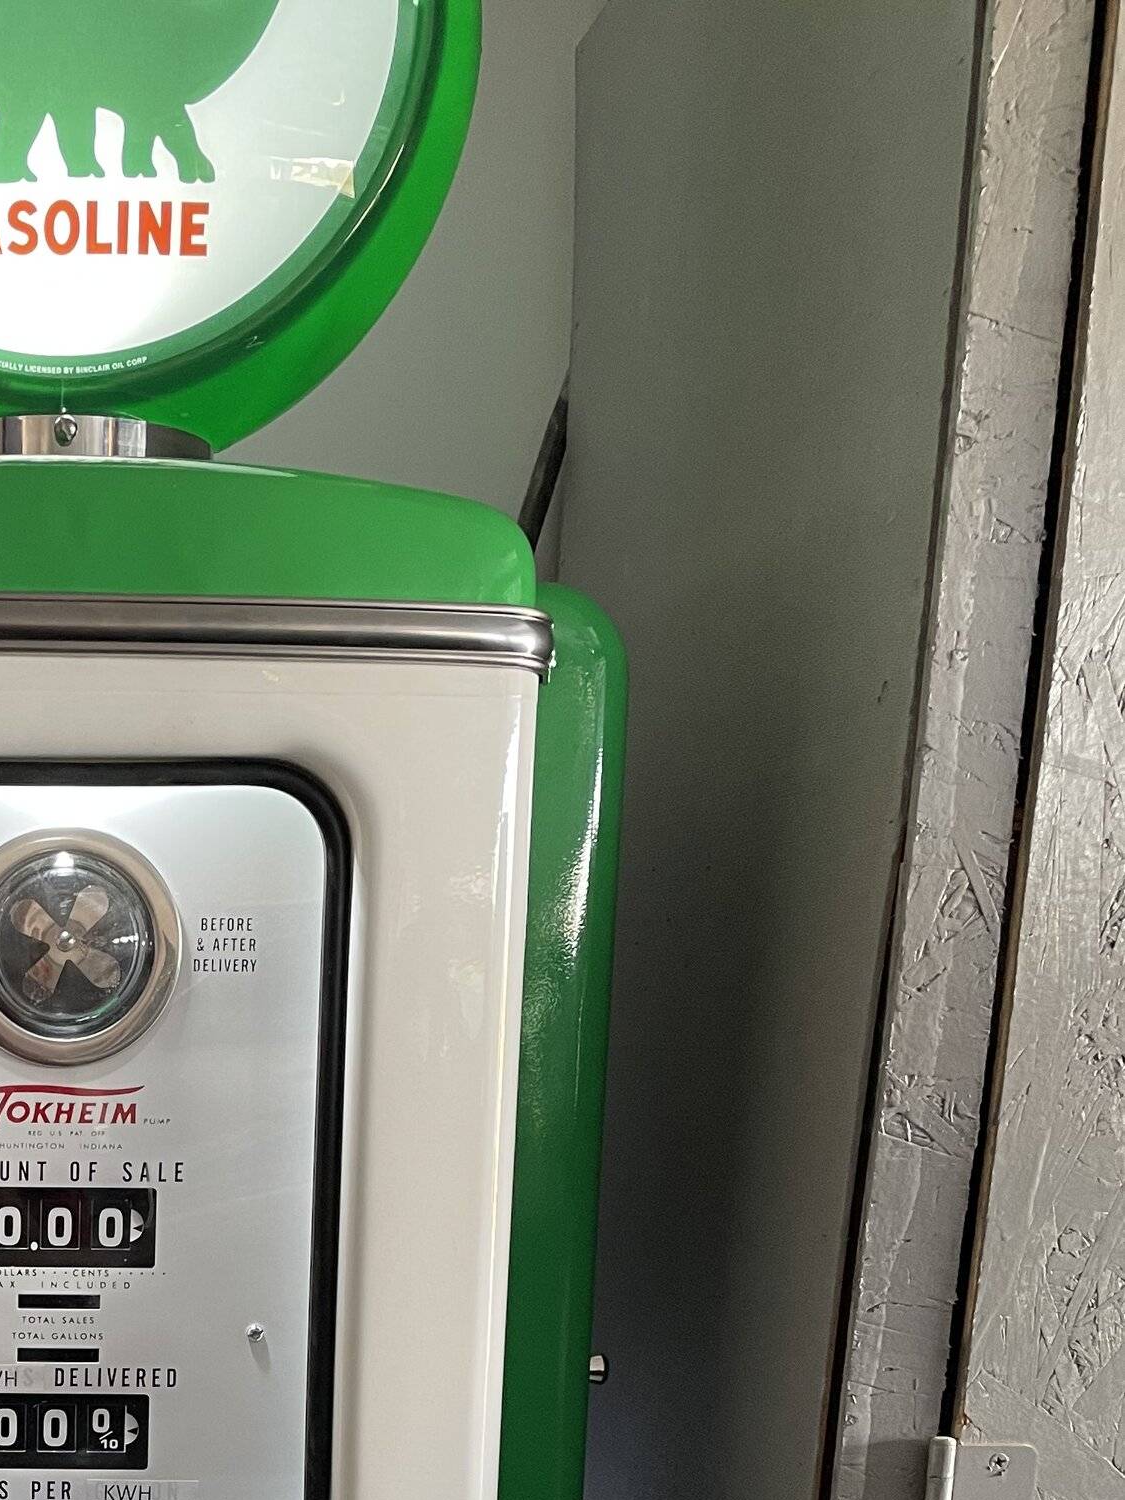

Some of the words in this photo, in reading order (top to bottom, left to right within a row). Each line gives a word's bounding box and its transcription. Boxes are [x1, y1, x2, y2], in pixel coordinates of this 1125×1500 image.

[24, 365, 61, 374] LICENSED
[63, 366, 74, 374] BY
[75, 363, 111, 374] SINCLAIR
[112, 362, 124, 370] OIL
[126, 356, 148, 368] CORP
[201, 918, 253, 931] BEFORE
[196, 937, 204, 952] &
[213, 937, 256, 952] AFTER
[193, 959, 257, 972] DELIVERY
[0, 1142, 65, 1150] HUNTINGTON
[70, 1161, 98, 1182] OF
[122, 1161, 184, 1183] SALE
[72, 1269, 110, 1278] CENTS
[41, 1281, 131, 1290] INCLUDED
[22, 1316, 56, 1324] TOTAL
[62, 1316, 95, 1325] SALES
[12, 1332, 46, 1340] TOTAL
[51, 1332, 104, 1341] GALLONS
[54, 1367, 177, 1388] DELIVERED
[31, 1481, 72, 1500] PER
